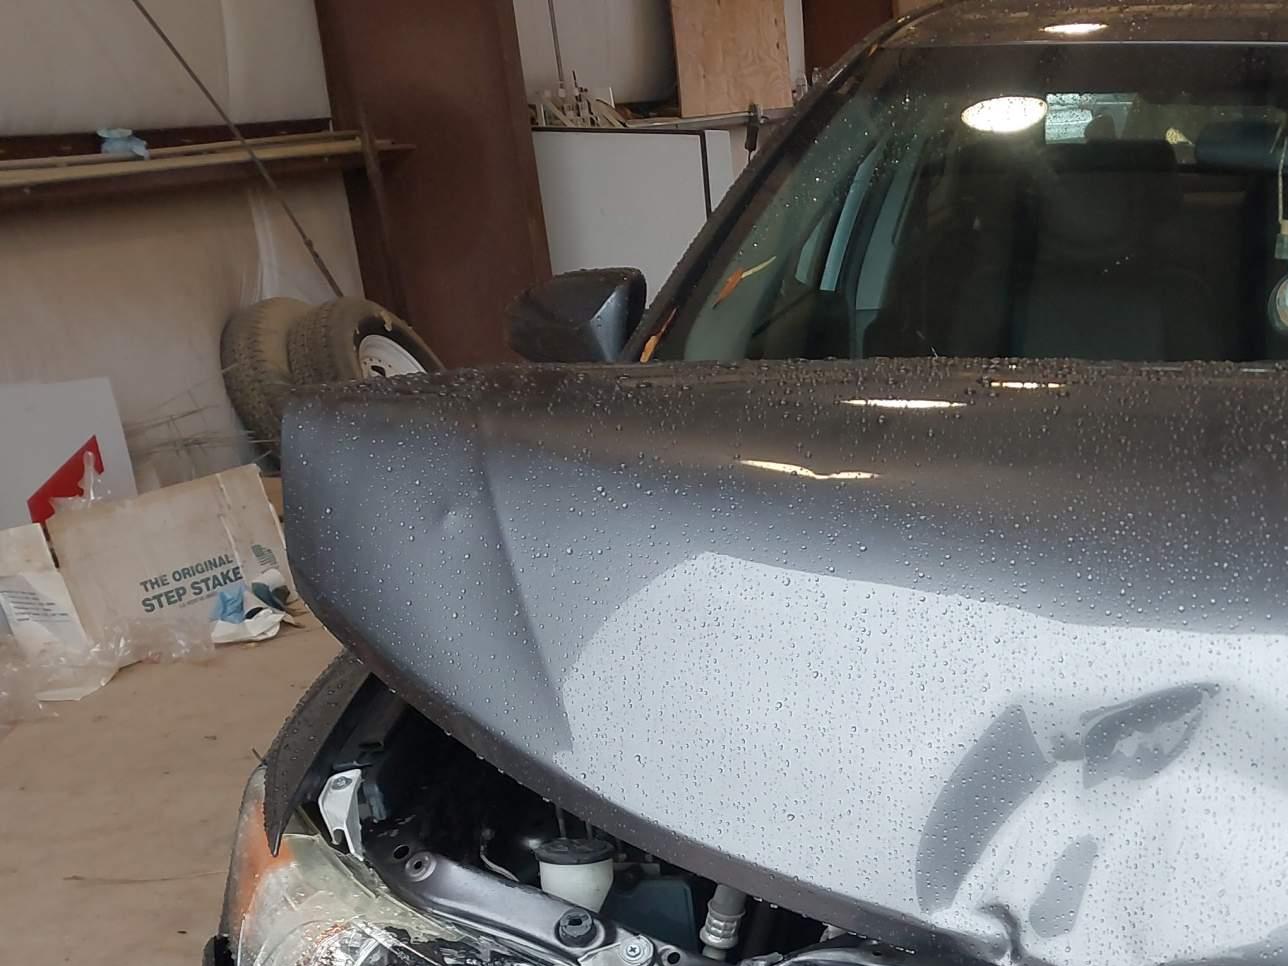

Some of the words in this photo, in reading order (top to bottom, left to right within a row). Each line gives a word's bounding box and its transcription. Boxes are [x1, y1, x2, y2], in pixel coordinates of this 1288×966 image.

[140, 574, 170, 593] THE
[172, 553, 234, 582] ORIGINAL
[142, 586, 187, 613] STEP
[190, 566, 243, 596] STAKE
